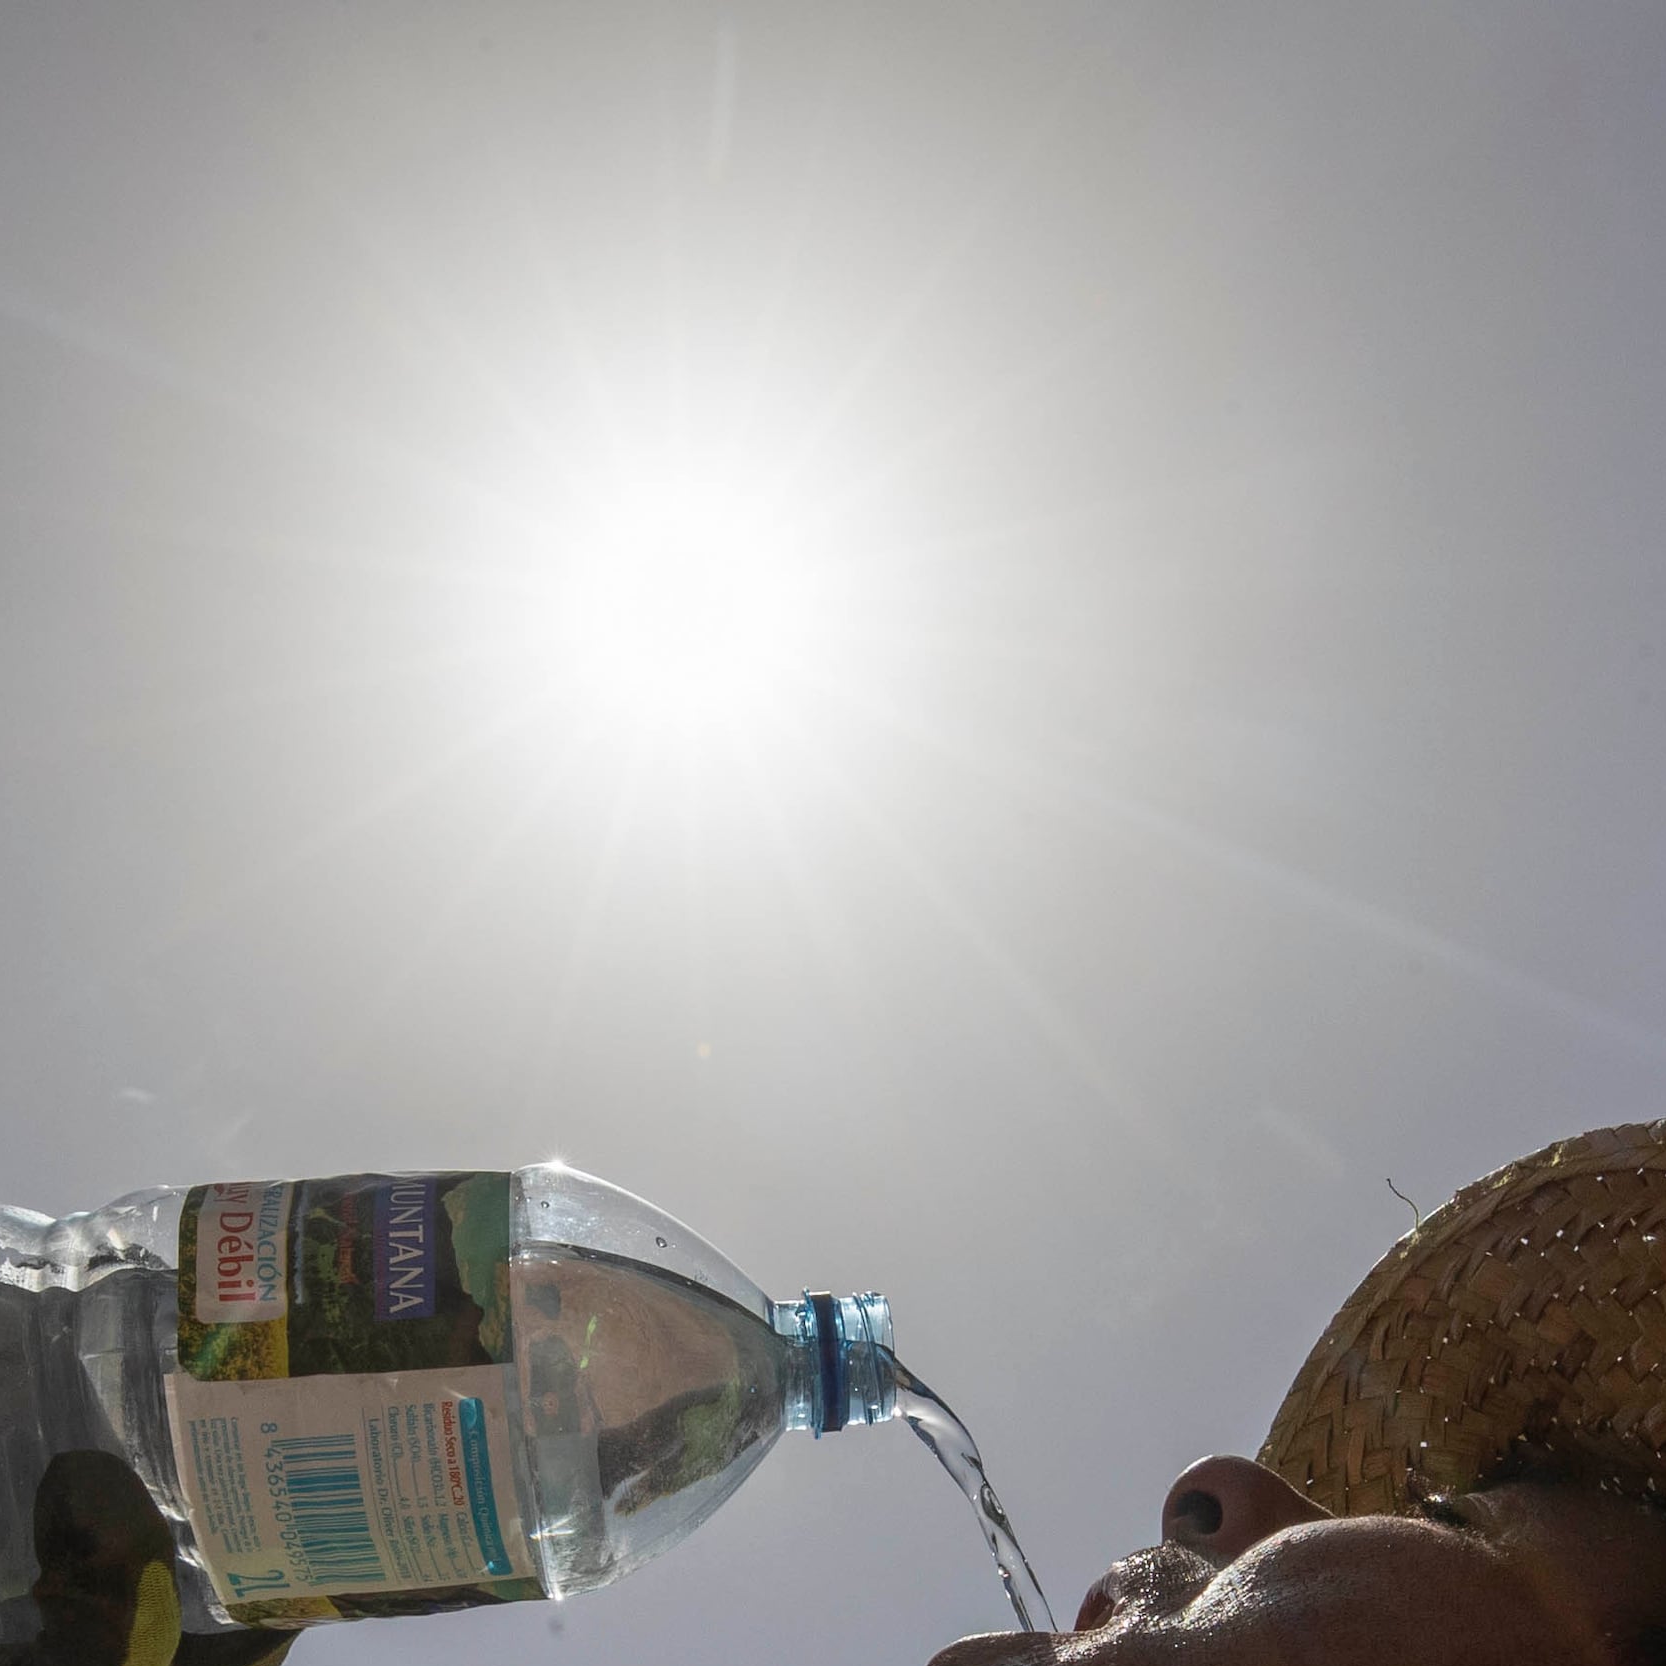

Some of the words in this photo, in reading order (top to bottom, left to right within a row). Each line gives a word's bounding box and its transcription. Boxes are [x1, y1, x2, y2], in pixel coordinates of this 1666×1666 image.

[217, 1211, 256, 1302] Débil
[442, 1401, 457, 1436] Residuo
[444, 1436, 457, 1458] Seco
[369, 1419, 386, 1486] Laboratorio
[378, 1488, 389, 1505] Dr.
